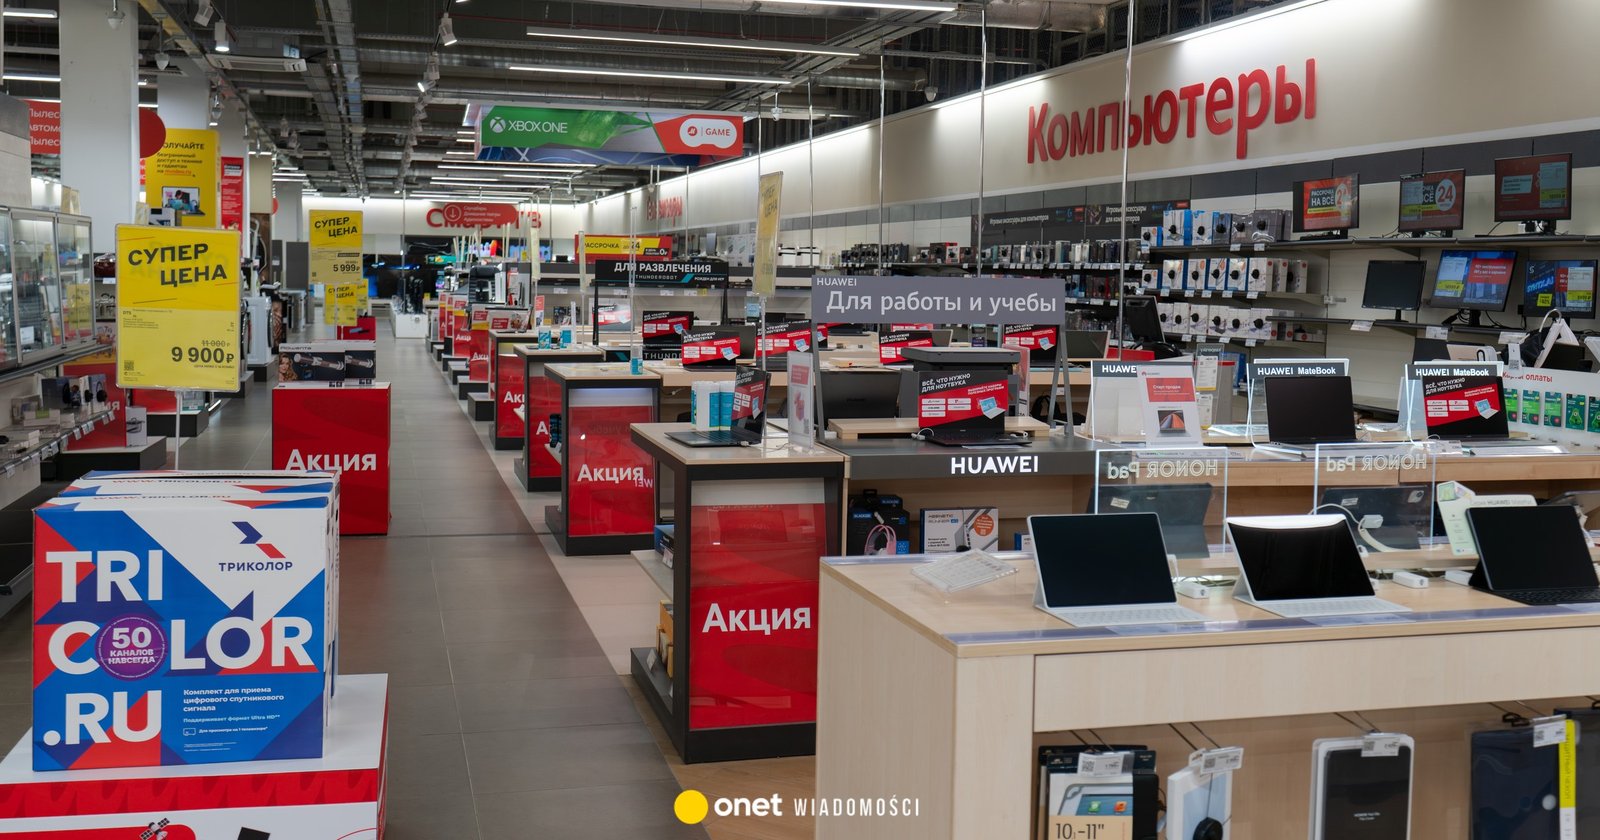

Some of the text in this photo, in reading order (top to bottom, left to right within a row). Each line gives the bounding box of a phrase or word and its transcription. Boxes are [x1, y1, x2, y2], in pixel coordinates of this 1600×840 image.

[1027, 58, 1316, 164] Компьютеры
[508, 120, 568, 134] XBOX ONE
[705, 127, 730, 137] GAME
[163, 142, 204, 150] ОЛУЧАЙТЕ
[1438, 185, 1453, 203] 24
[1311, 197, 1321, 206] НА
[314, 217, 350, 229] СУПЕР
[328, 226, 358, 237] ЦЕНА
[128, 243, 209, 267] СУПЕР
[333, 264, 339, 272] 5
[639, 263, 712, 273] РАЗВЛЕЧЕНИЯ
[160, 264, 228, 287] ЦЕНА
[816, 277, 857, 287] HUAWEI
[826, 290, 1057, 316] Для работы и учебы
[171, 346, 183, 362] 9
[1101, 365, 1137, 374] HUAWE
[1257, 366, 1336, 375] HUAWEI MateBook
[1415, 368, 1490, 376] HUAWEI MateBook
[948, 373, 971, 382] НУЖНО
[1447, 377, 1465, 385] НУЖНО
[1526, 374, 1552, 383] оплаты
[921, 379, 967, 393] ДЛЯ НОУТБУКА
[1437, 383, 1463, 392] НОУТБУКА
[285, 448, 376, 475] Акция
[951, 455, 1038, 474] HUAWEI
[577, 463, 644, 484] Акция
[218, 561, 293, 572] ТРИКОЛОР
[46, 549, 163, 603] TRI
[702, 603, 811, 635] Акция
[112, 626, 152, 649] 50
[109, 649, 154, 657] КАНАЛОВ
[241, 687, 272, 695] приема
[183, 694, 285, 704] цифрового спутникового
[43, 690, 162, 746] .RU
